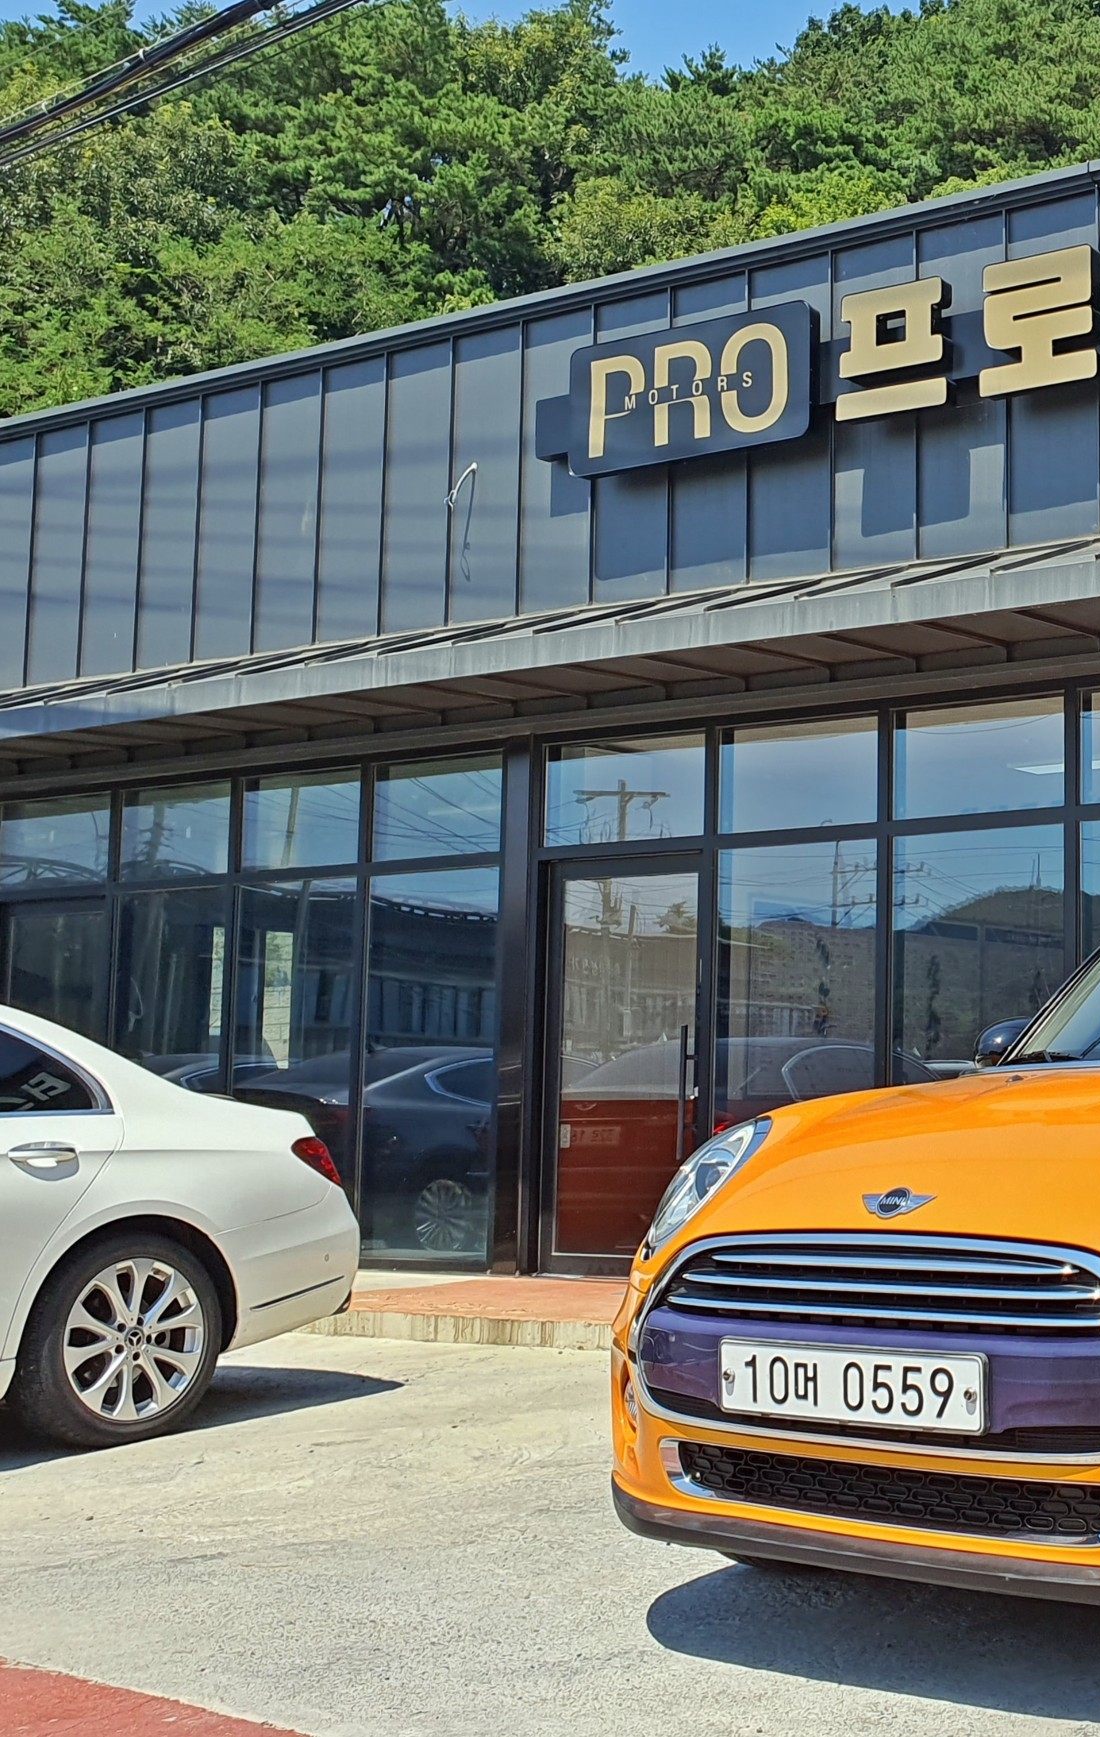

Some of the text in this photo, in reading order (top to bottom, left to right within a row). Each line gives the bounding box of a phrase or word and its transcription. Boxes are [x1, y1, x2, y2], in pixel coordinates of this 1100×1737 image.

[588, 322, 789, 458] PRO
[624, 371, 753, 411] MOTORS
[744, 1353, 954, 1419] 10머 0559
